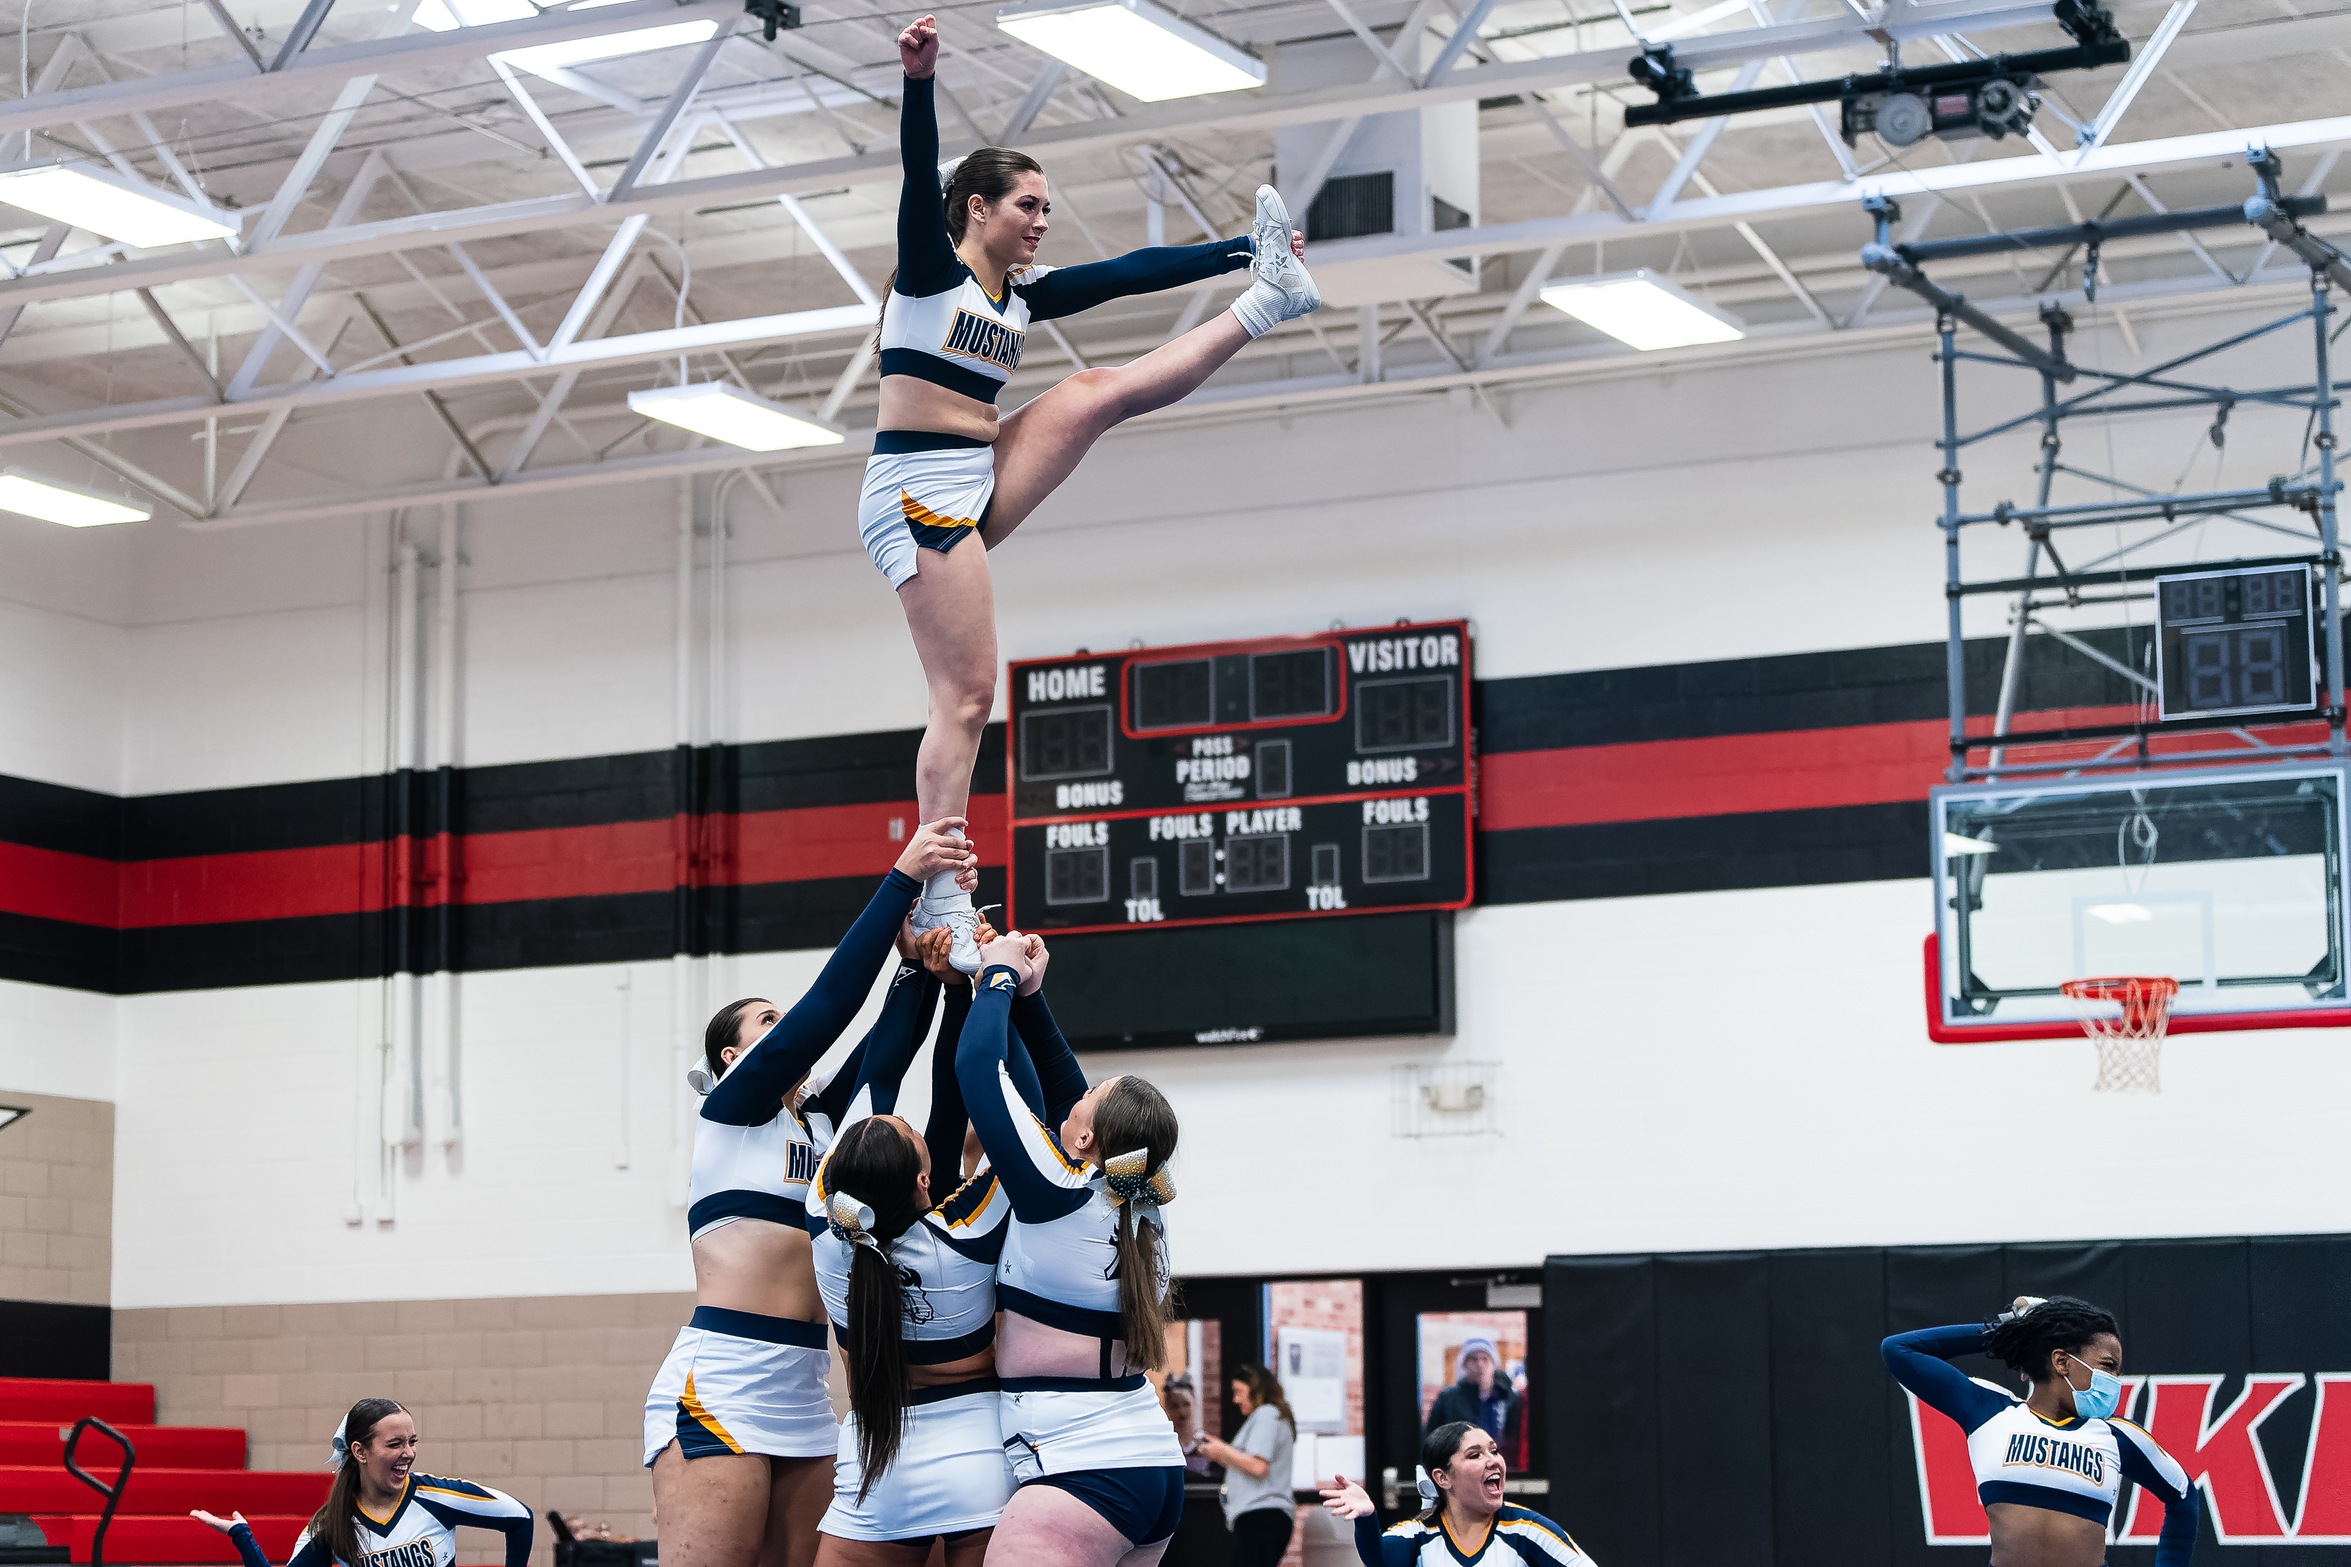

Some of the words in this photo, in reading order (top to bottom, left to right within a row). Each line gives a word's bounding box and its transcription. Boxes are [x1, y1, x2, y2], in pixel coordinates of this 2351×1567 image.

[1348, 634, 1459, 673] VISITOR
[1028, 666, 1106, 702] HOME
[1176, 755, 1251, 784] PERIOD
[1347, 756, 1417, 785] BONUS
[1056, 780, 1123, 809] BONUS
[1149, 812, 1213, 841] FOULS
[1226, 806, 1301, 835] PLAYER
[1363, 797, 1429, 824] FOULS
[1046, 821, 1109, 849] FOULS
[1125, 898, 1164, 923] TOL
[1306, 885, 1346, 911] TOL
[2005, 1433, 2104, 1483] MUSTANGS
